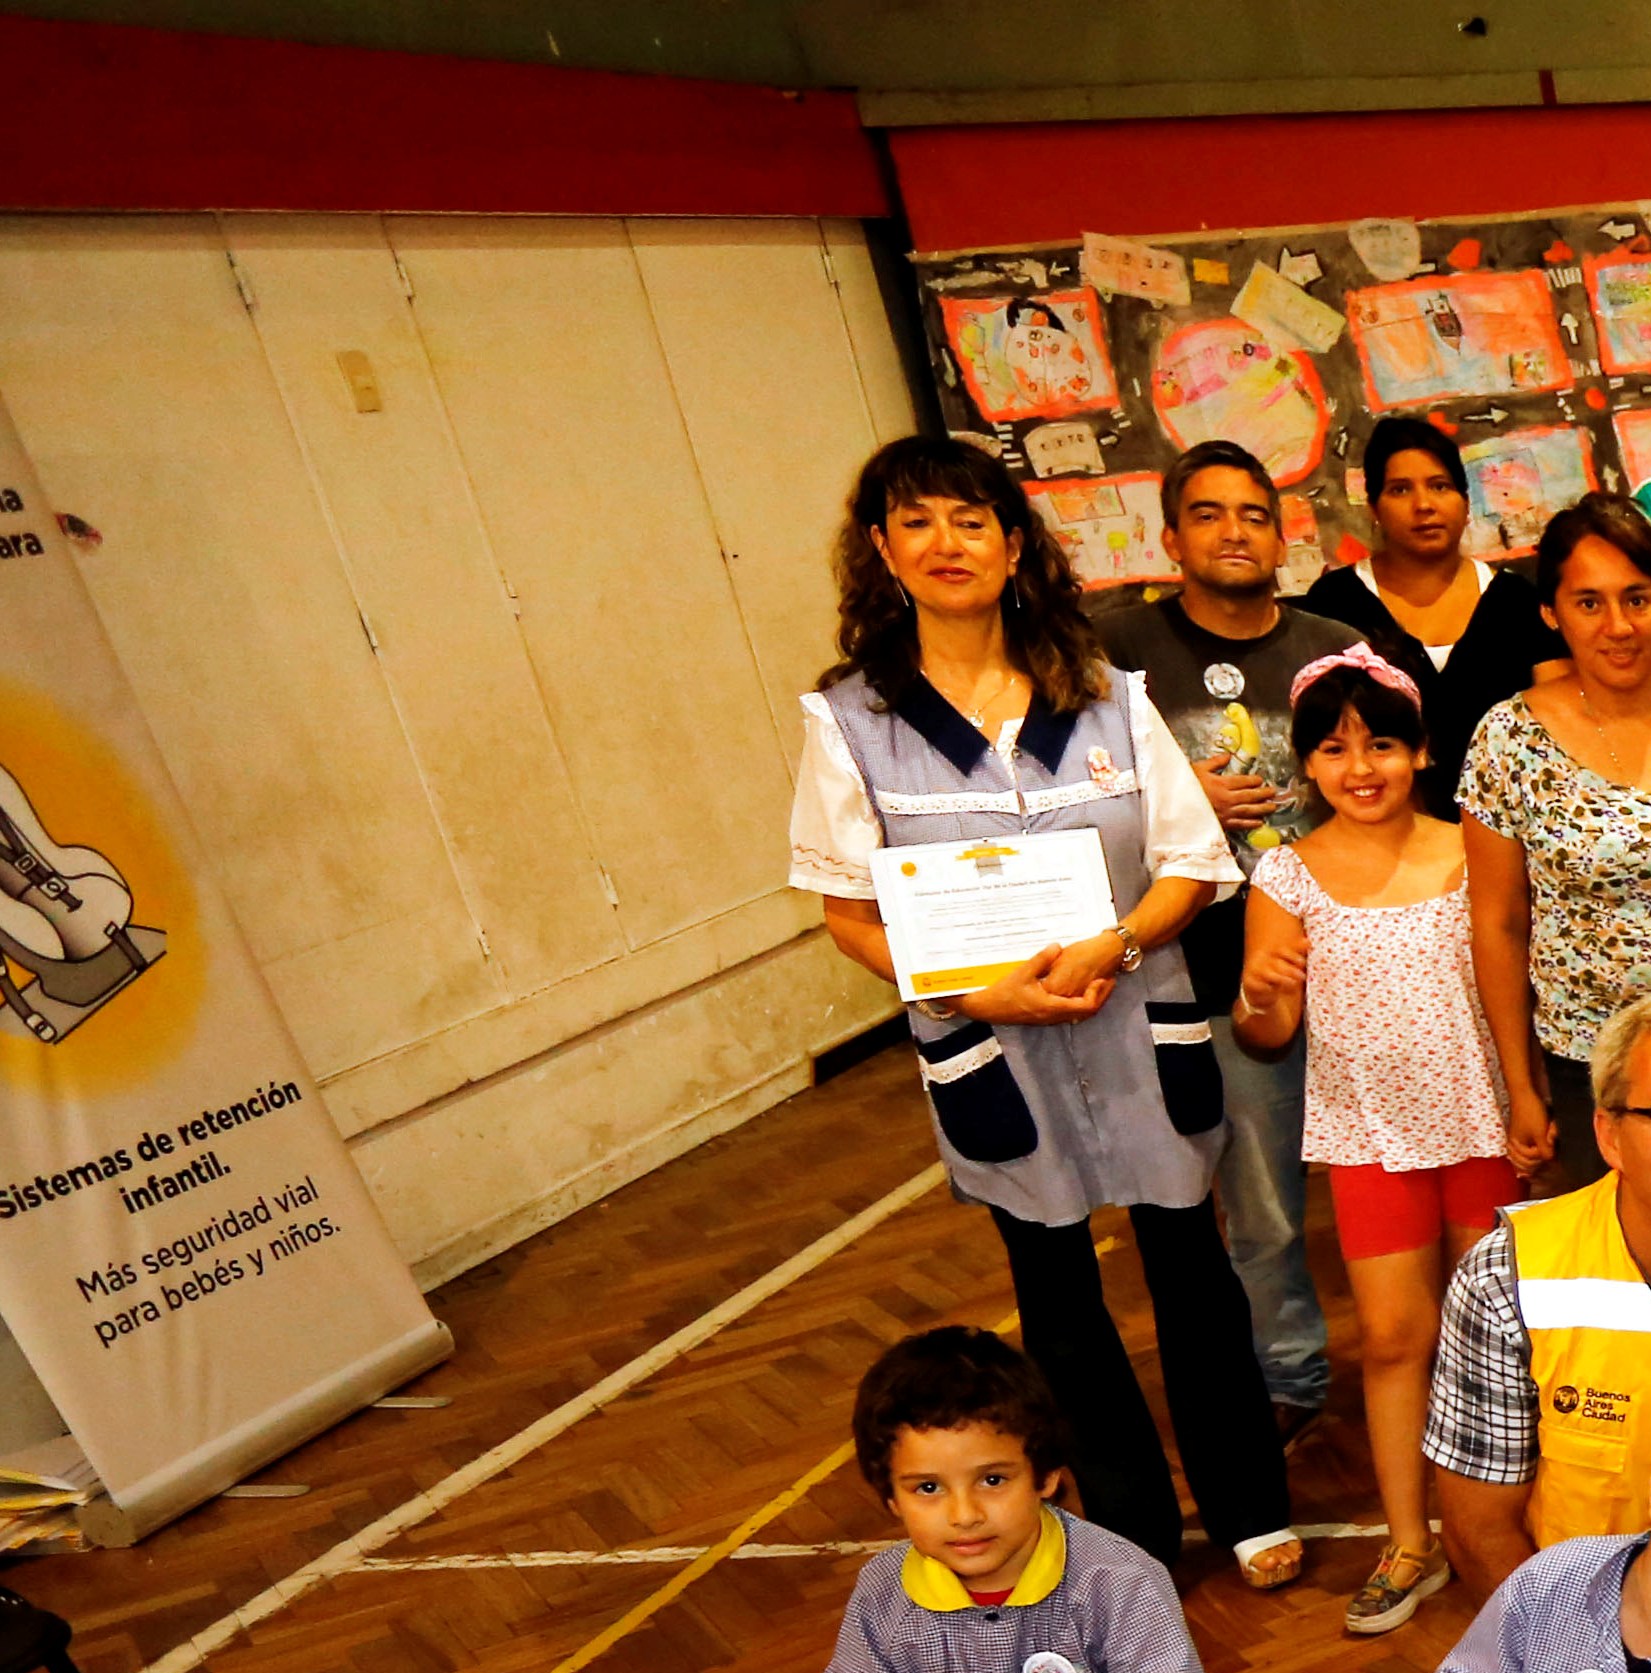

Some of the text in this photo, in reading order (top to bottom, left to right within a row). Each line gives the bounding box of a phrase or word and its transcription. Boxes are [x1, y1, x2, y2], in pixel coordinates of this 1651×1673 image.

[0, 488, 24, 513] a
[0, 1081, 302, 1219] Sistemas de retención
[118, 1151, 231, 1214] infantil.
[75, 1175, 320, 1303] Más seguridad vial
[93, 1216, 341, 1349] para bebés y niños.
[1582, 1407, 1626, 1423] Ciudad
[1585, 1398, 1614, 1411] Aires
[1586, 1387, 1631, 1403] Buenos
